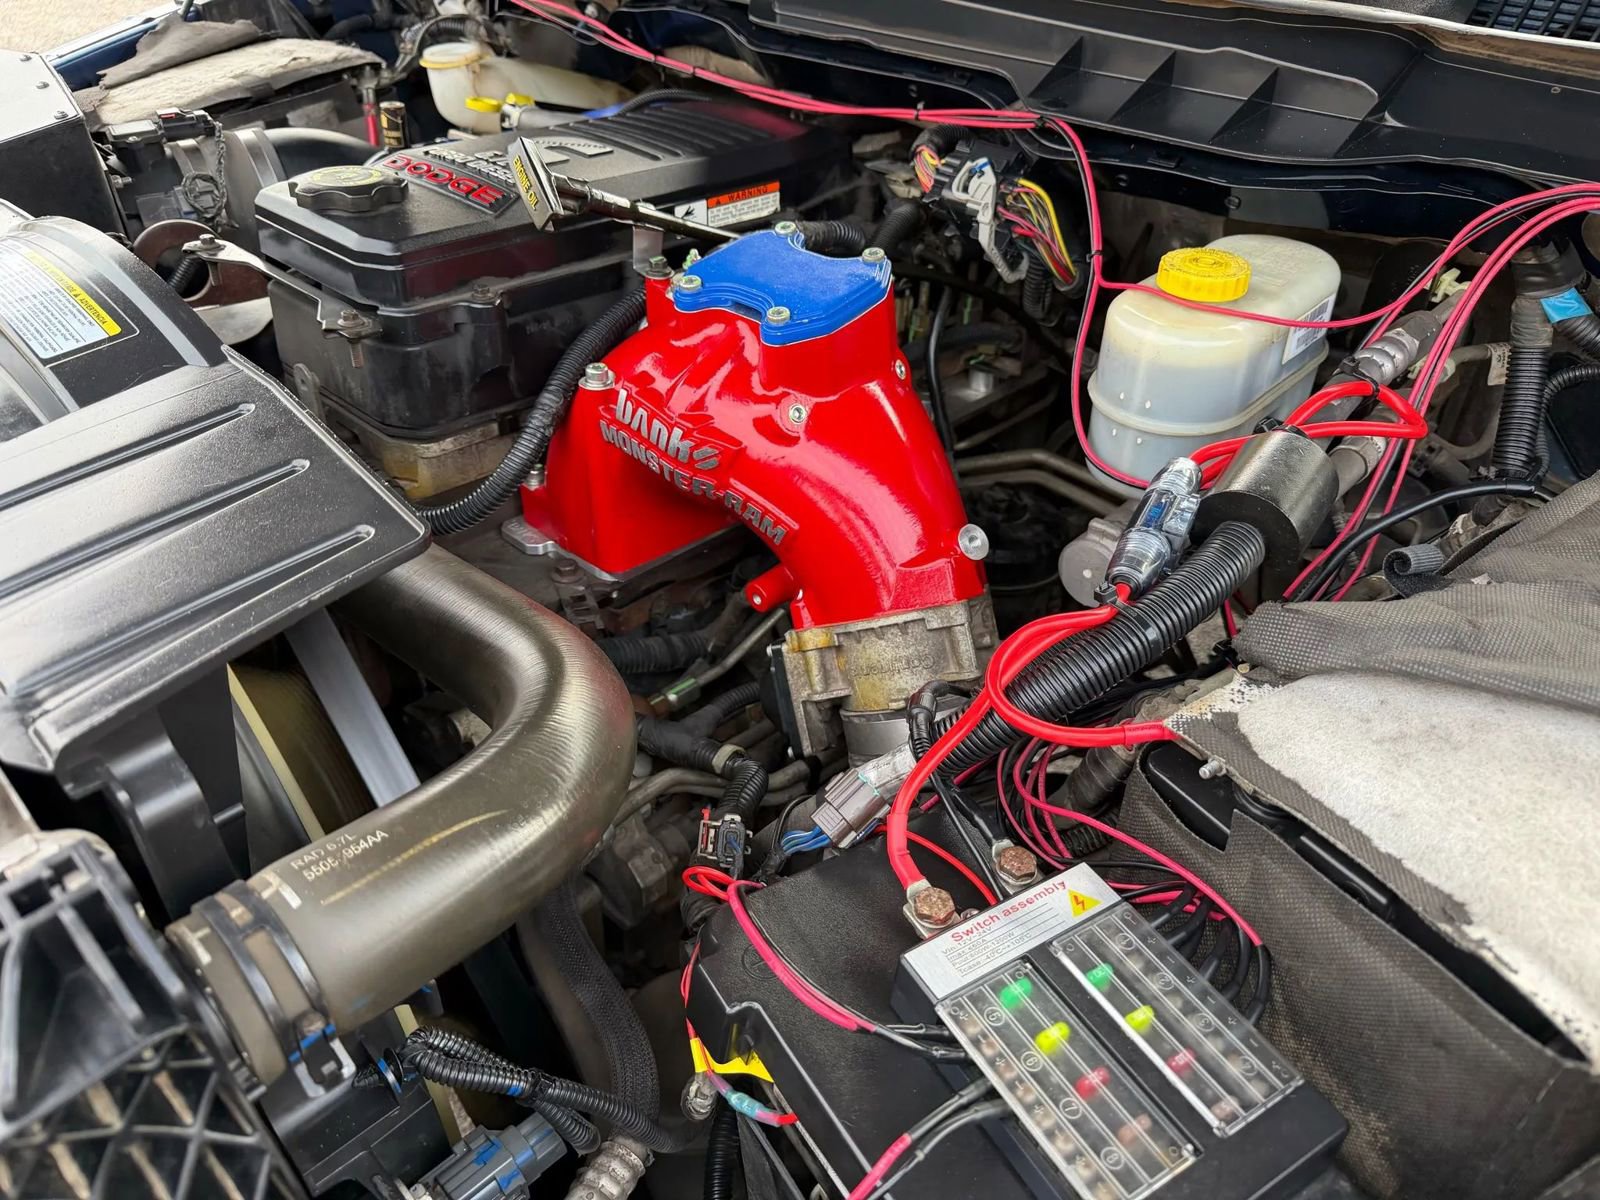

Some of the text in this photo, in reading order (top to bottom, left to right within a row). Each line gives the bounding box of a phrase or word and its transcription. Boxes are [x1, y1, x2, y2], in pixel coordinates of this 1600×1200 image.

[383, 154, 505, 205] DODGE
[513, 154, 539, 211] ENGINE OIL
[727, 186, 769, 202] WARNING
[79, 298, 108, 326] ADVERTENCIA
[600, 419, 788, 546] MONSTER-RAM
[290, 832, 357, 870] RAD 6.7L
[951, 880, 1067, 943] Switch assembly
